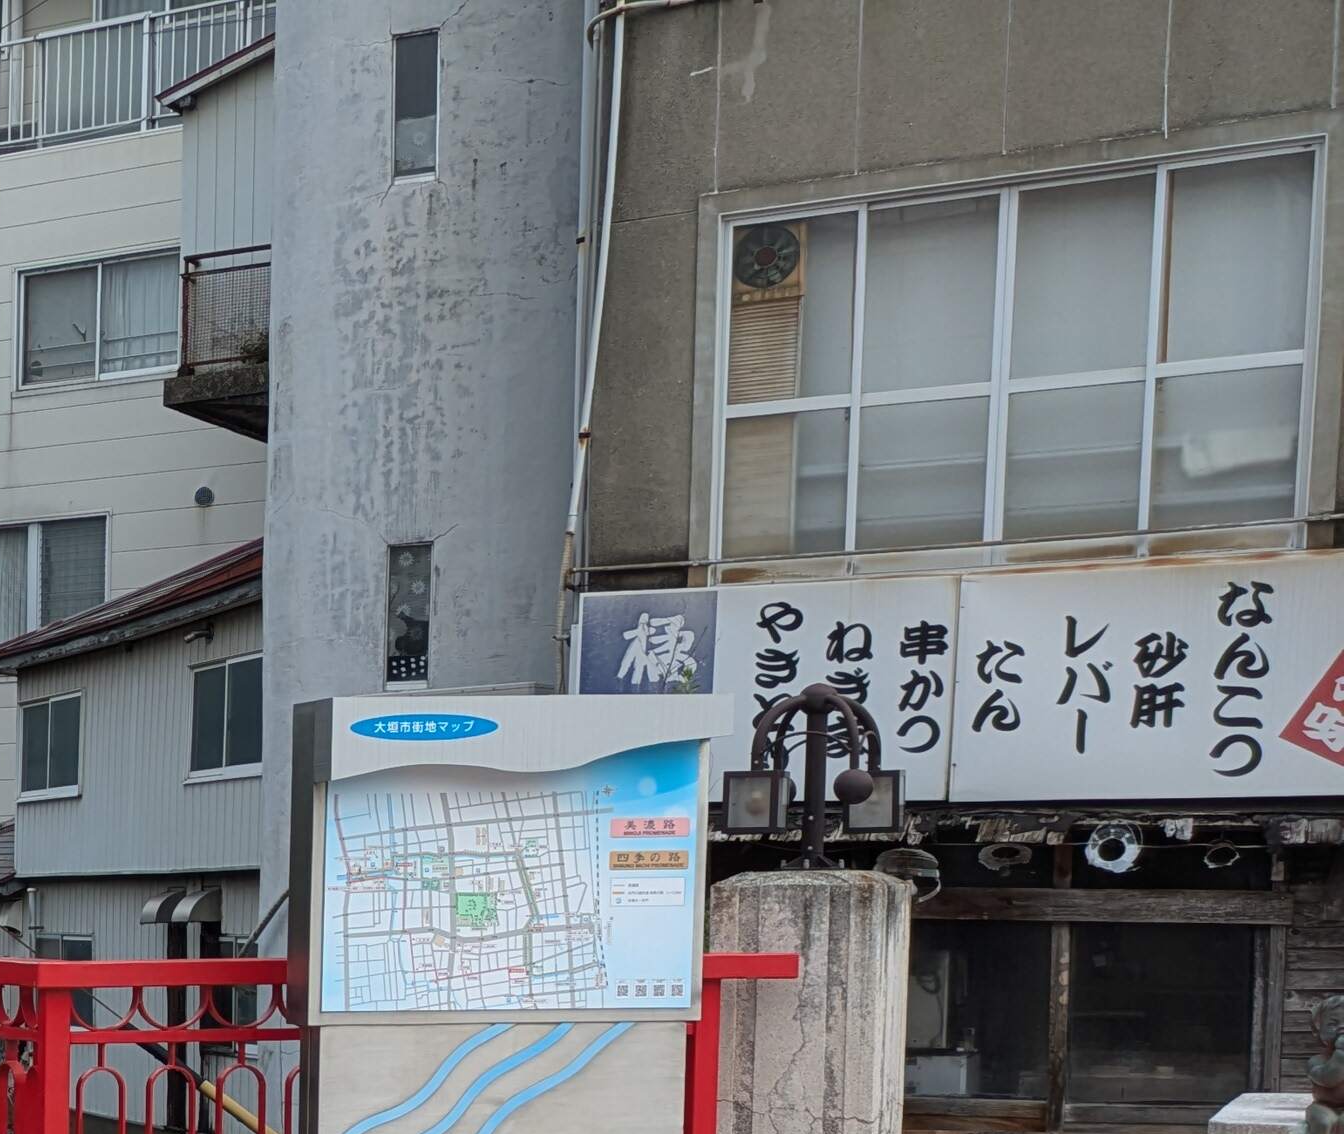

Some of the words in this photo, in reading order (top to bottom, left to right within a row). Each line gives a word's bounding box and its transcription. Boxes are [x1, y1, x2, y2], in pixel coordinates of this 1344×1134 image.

[373, 720, 475, 734] 大垣市街地マップ
[897, 620, 948, 753] 串かつ
[972, 640, 1025, 732] たん
[1056, 615, 1113, 754] レバー
[1130, 631, 1189, 729] 砂肝
[1209, 581, 1275, 777] なんこつ
[617, 853, 680, 863] 四季の路
